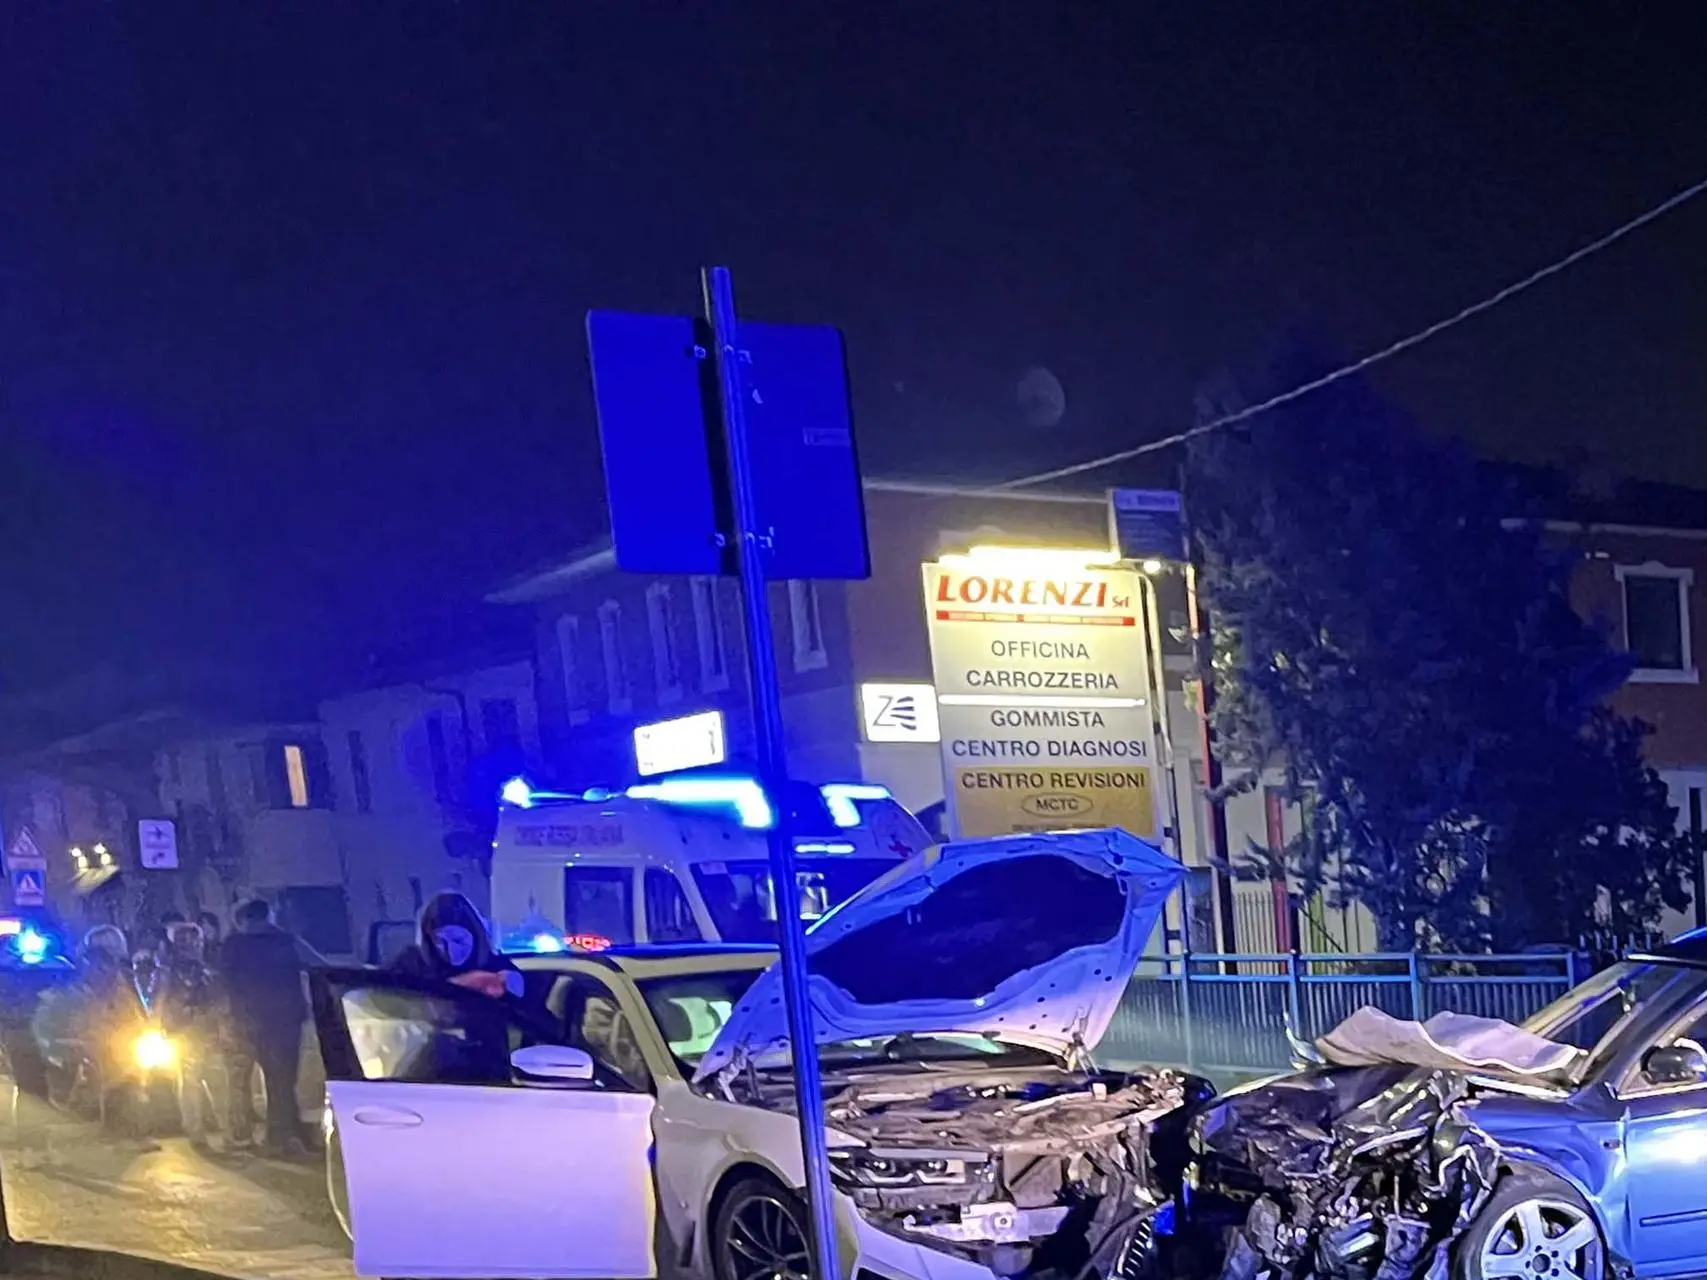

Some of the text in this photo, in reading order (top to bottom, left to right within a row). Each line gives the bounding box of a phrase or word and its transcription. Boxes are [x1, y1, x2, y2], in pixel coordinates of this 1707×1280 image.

[936, 575, 1107, 607] LORENZI
[991, 640, 1090, 659] OFFICINA
[966, 670, 1119, 689] CARROZZERIA
[991, 710, 1105, 727] GOMMISTA
[952, 740, 1147, 757] CENTRO DIAGNOSI
[962, 772, 1146, 788] CENTRO REVISIONI
[1035, 798, 1079, 811] MCTC
